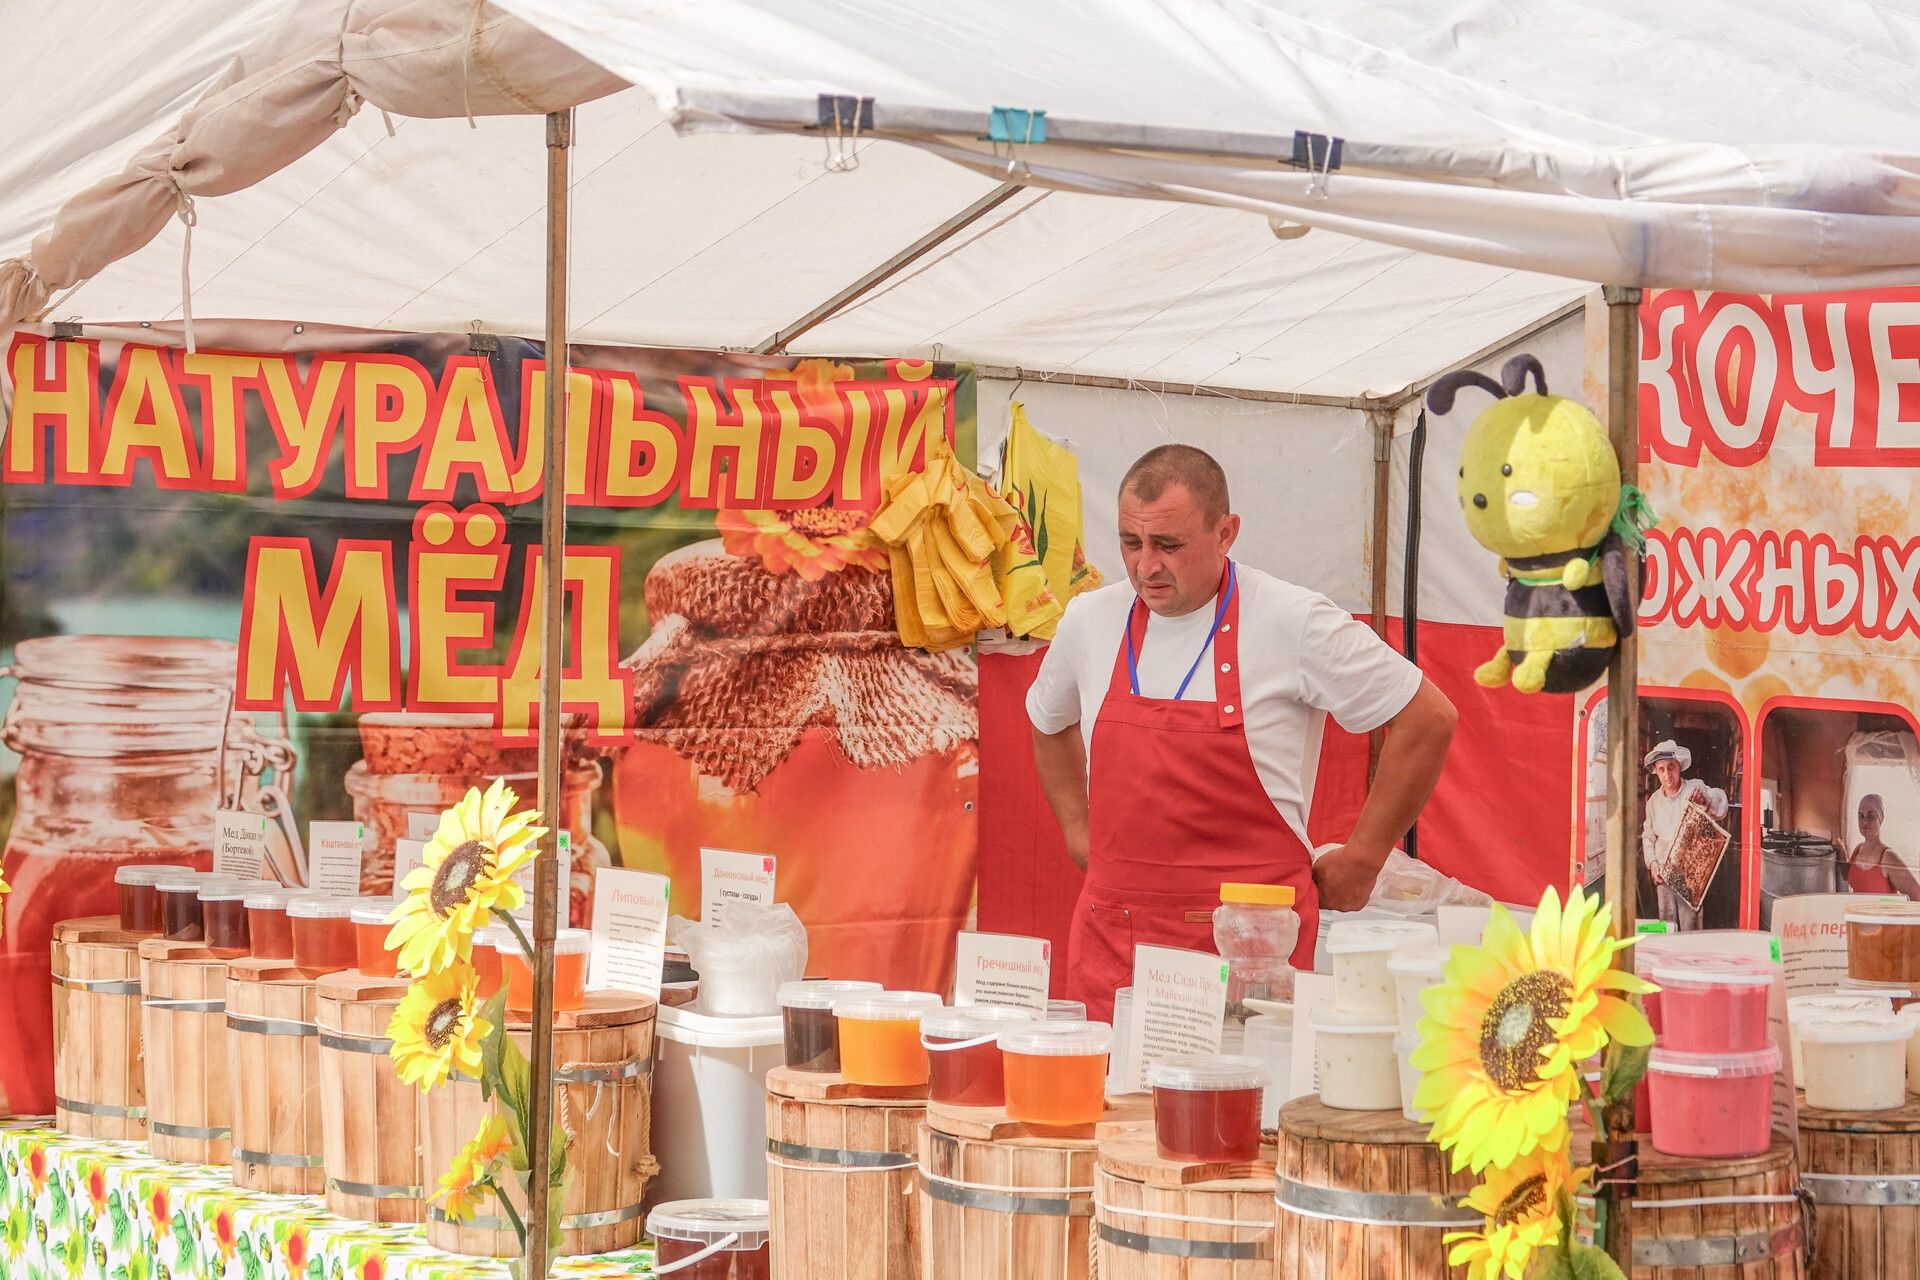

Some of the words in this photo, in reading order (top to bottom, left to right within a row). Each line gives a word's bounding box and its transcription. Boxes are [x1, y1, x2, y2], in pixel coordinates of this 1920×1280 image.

[3, 332, 956, 511] НАТУРАЛЬНЫЙ
[235, 502, 634, 747] МЁД
[611, 889, 655, 906] Липовый
[1783, 923, 1807, 939] Мед
[1810, 923, 1818, 936] с
[977, 955, 1031, 973] Гречишный
[1148, 968, 1170, 984] Мед
